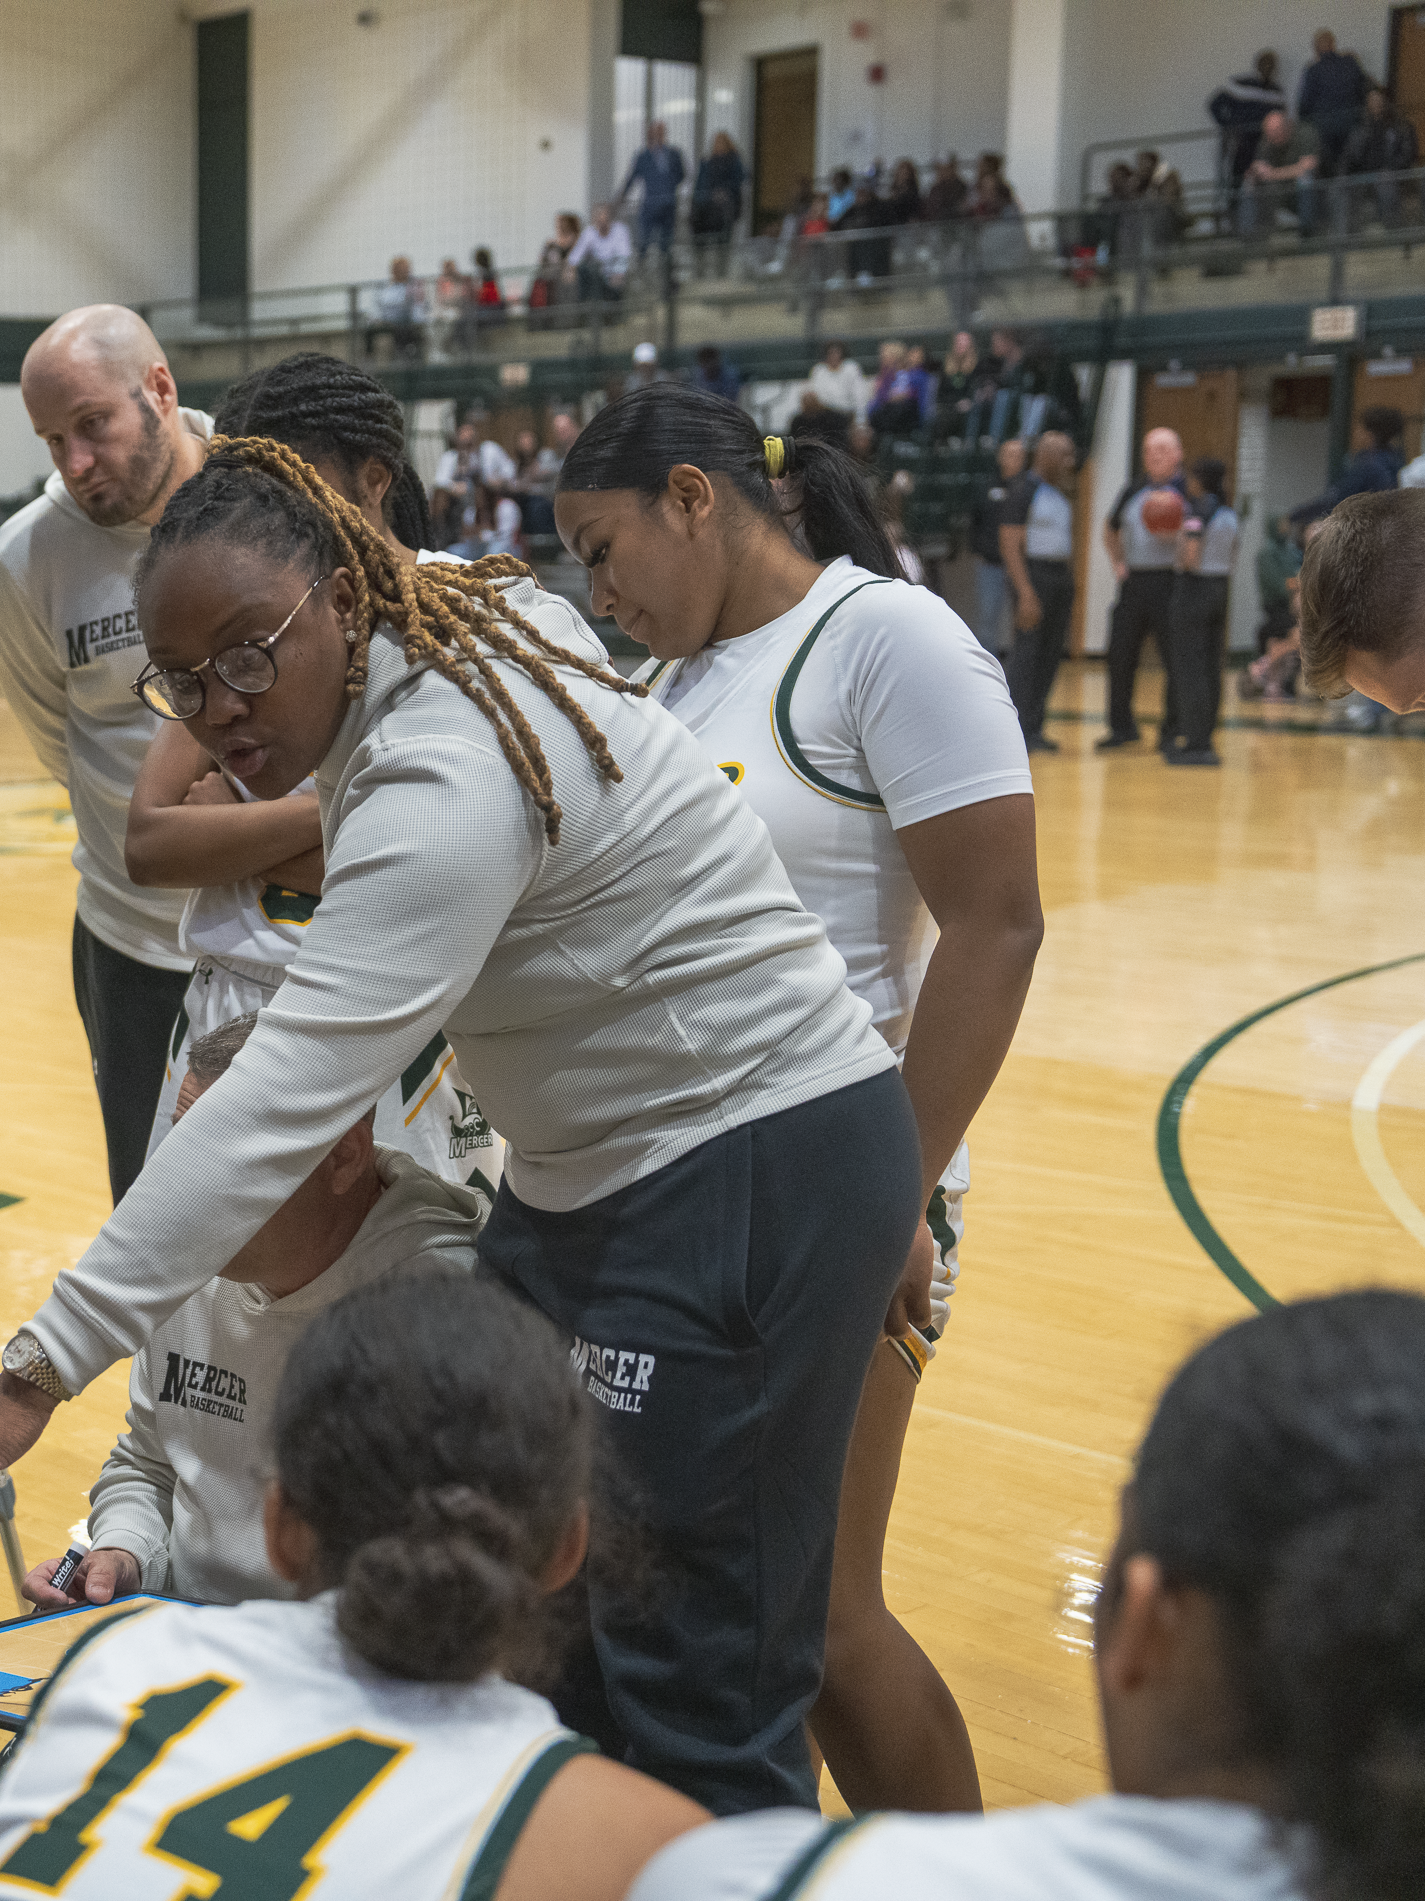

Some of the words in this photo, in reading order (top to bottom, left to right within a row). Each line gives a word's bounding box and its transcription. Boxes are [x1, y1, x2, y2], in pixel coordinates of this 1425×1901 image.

[65, 608, 137, 669] MERCE
[94, 633, 144, 656] BASKETBAL
[448, 1132, 493, 1159] MERCER
[159, 1351, 247, 1408] MERCER
[587, 1376, 642, 1413] BASKETBALL
[189, 1394, 245, 1423] BASKETBALL
